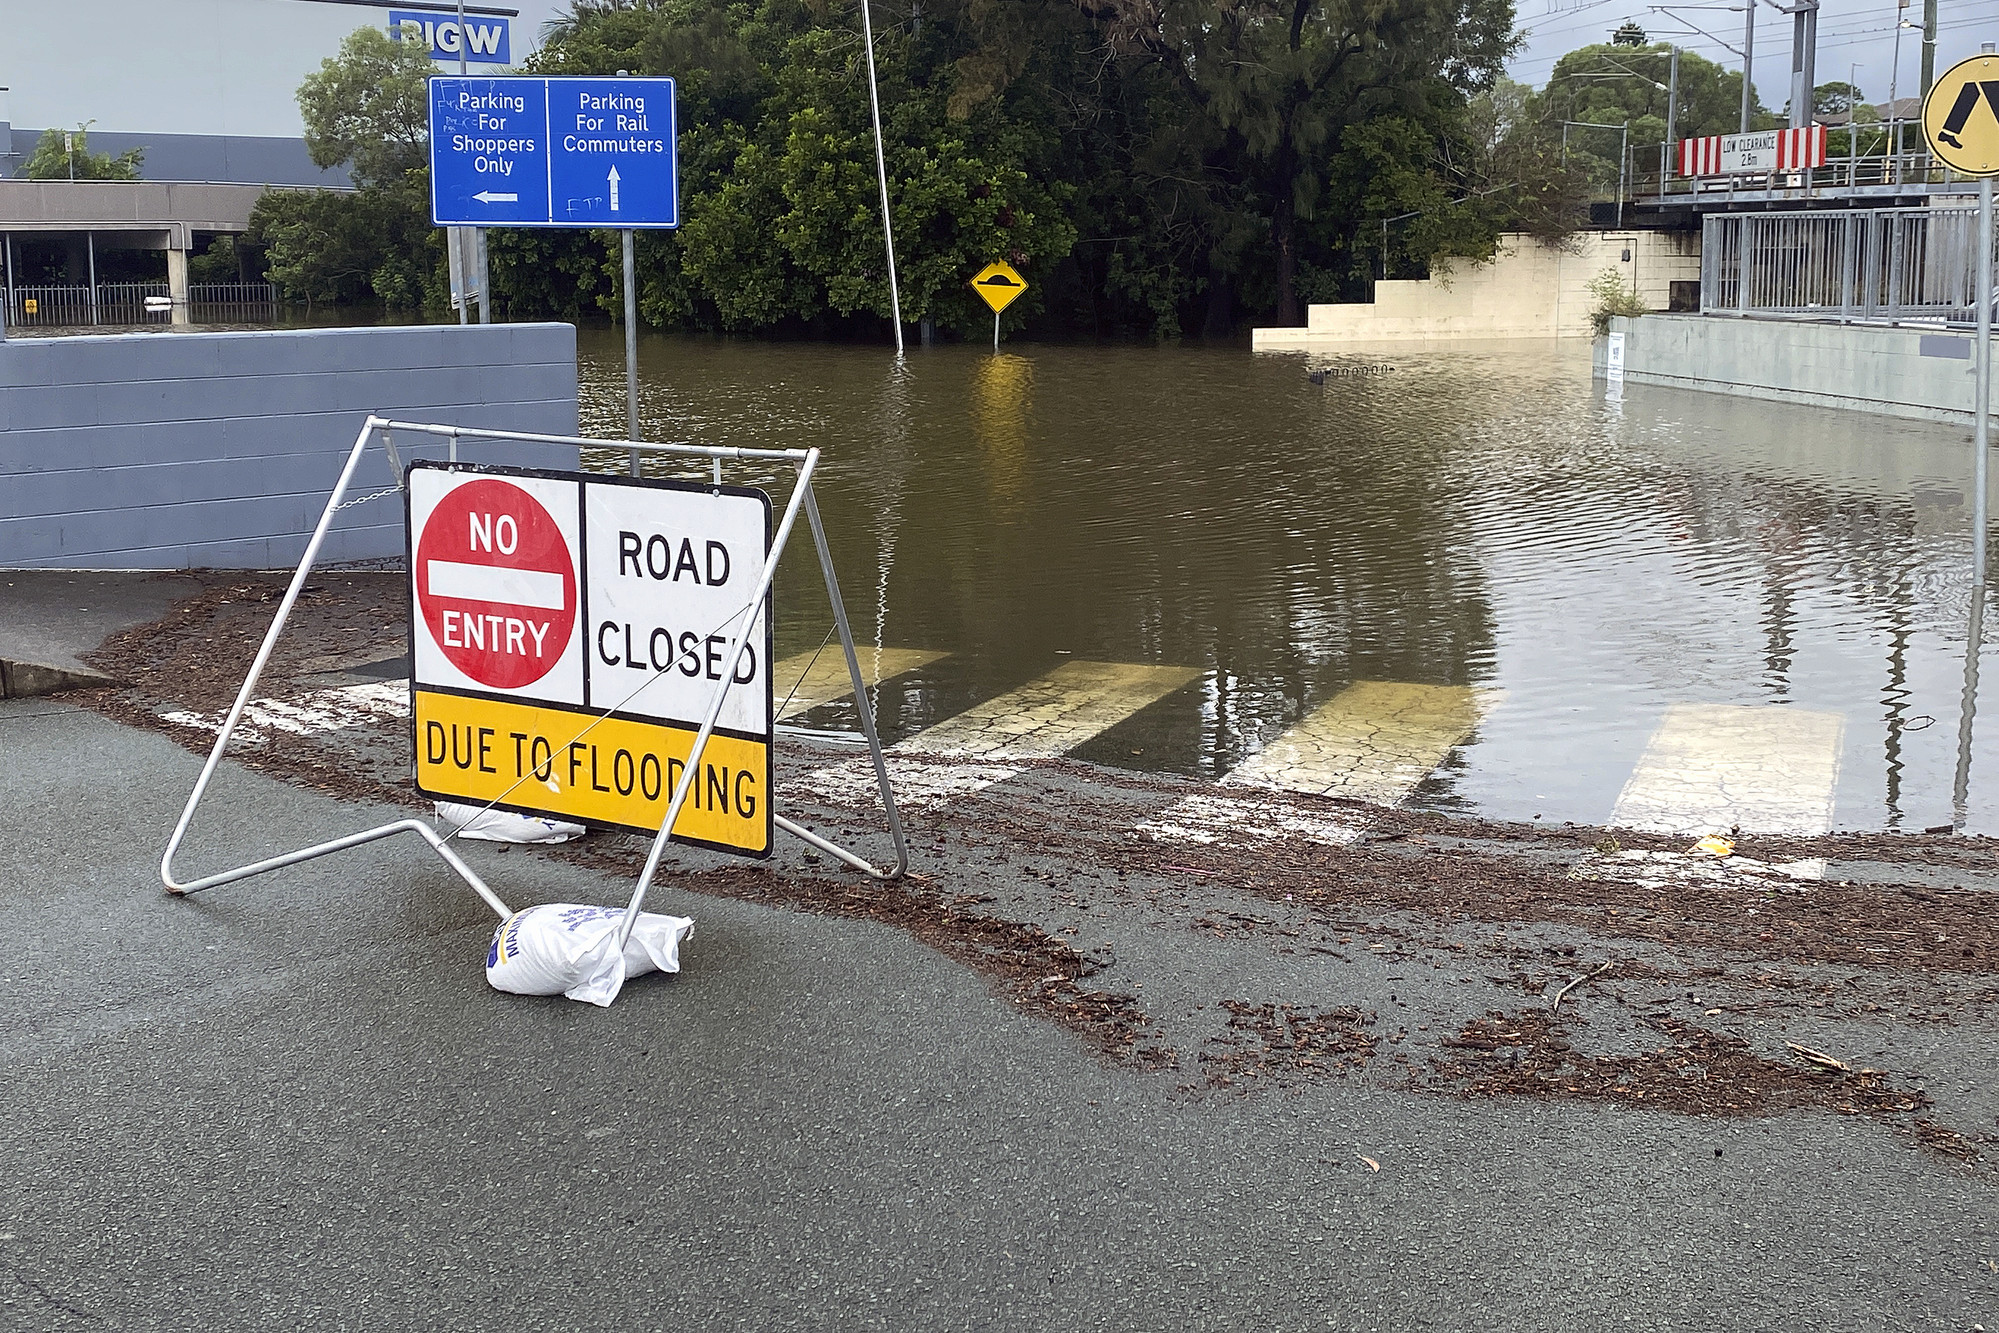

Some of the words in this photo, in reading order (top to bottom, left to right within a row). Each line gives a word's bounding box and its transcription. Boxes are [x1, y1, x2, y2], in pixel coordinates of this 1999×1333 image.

[459, 92, 524, 112] Parking
[579, 92, 645, 113] Parking
[479, 113, 507, 130] For
[576, 114, 604, 131] For
[616, 114, 649, 131] Rail
[452, 135, 535, 155] Shoppers
[563, 135, 664, 153] Commuters
[1723, 140, 1737, 153] LOW
[1739, 136, 1775, 152] CLEARANCE
[474, 156, 514, 176] Only
[469, 511, 518, 555] NO
[619, 530, 731, 587] ROAD
[442, 610, 550, 658] ENTRY
[598, 620, 757, 685] CLOSED
[426, 720, 497, 774] DUE
[510, 732, 552, 783] TO
[569, 742, 757, 819] FLOODING
